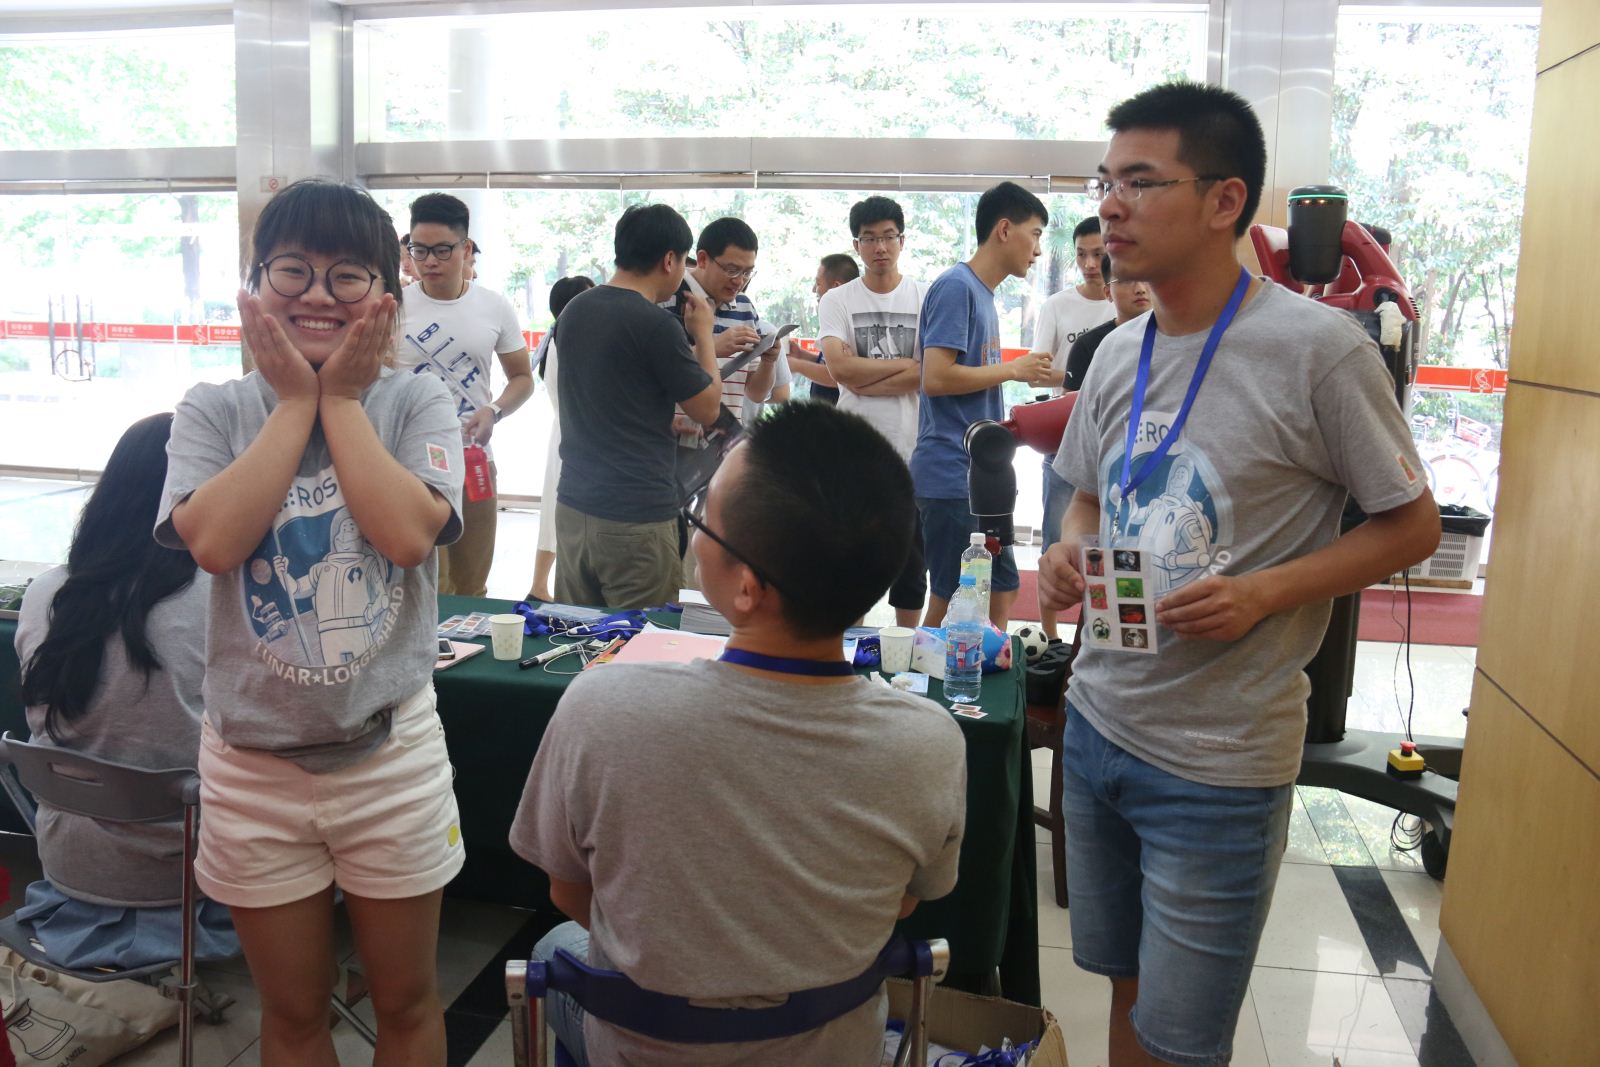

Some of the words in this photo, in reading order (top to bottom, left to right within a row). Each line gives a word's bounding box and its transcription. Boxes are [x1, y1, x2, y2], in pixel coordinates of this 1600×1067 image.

[296, 476, 338, 509] ROS
[254, 640, 311, 687] LUNAR
[322, 585, 405, 686] LOGGERHEAD
